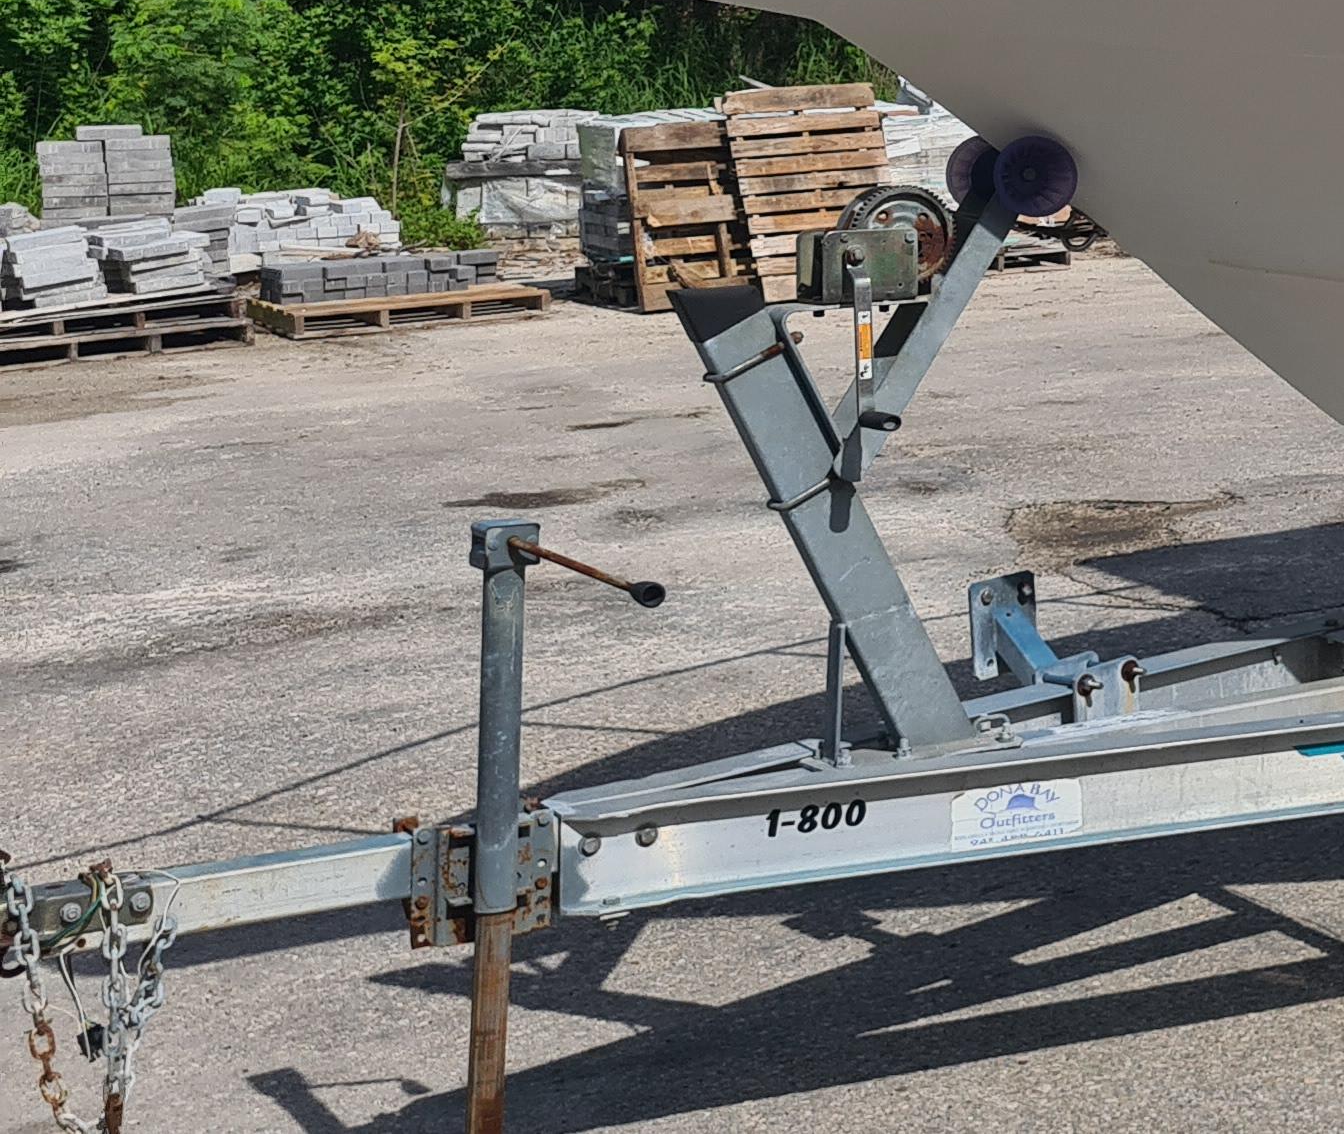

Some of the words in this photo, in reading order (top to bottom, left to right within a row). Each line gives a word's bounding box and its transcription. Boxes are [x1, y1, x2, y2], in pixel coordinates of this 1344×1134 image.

[974, 783, 1025, 812] DONA
[766, 799, 867, 838] 1-800
[980, 811, 1056, 829] Outfitters
